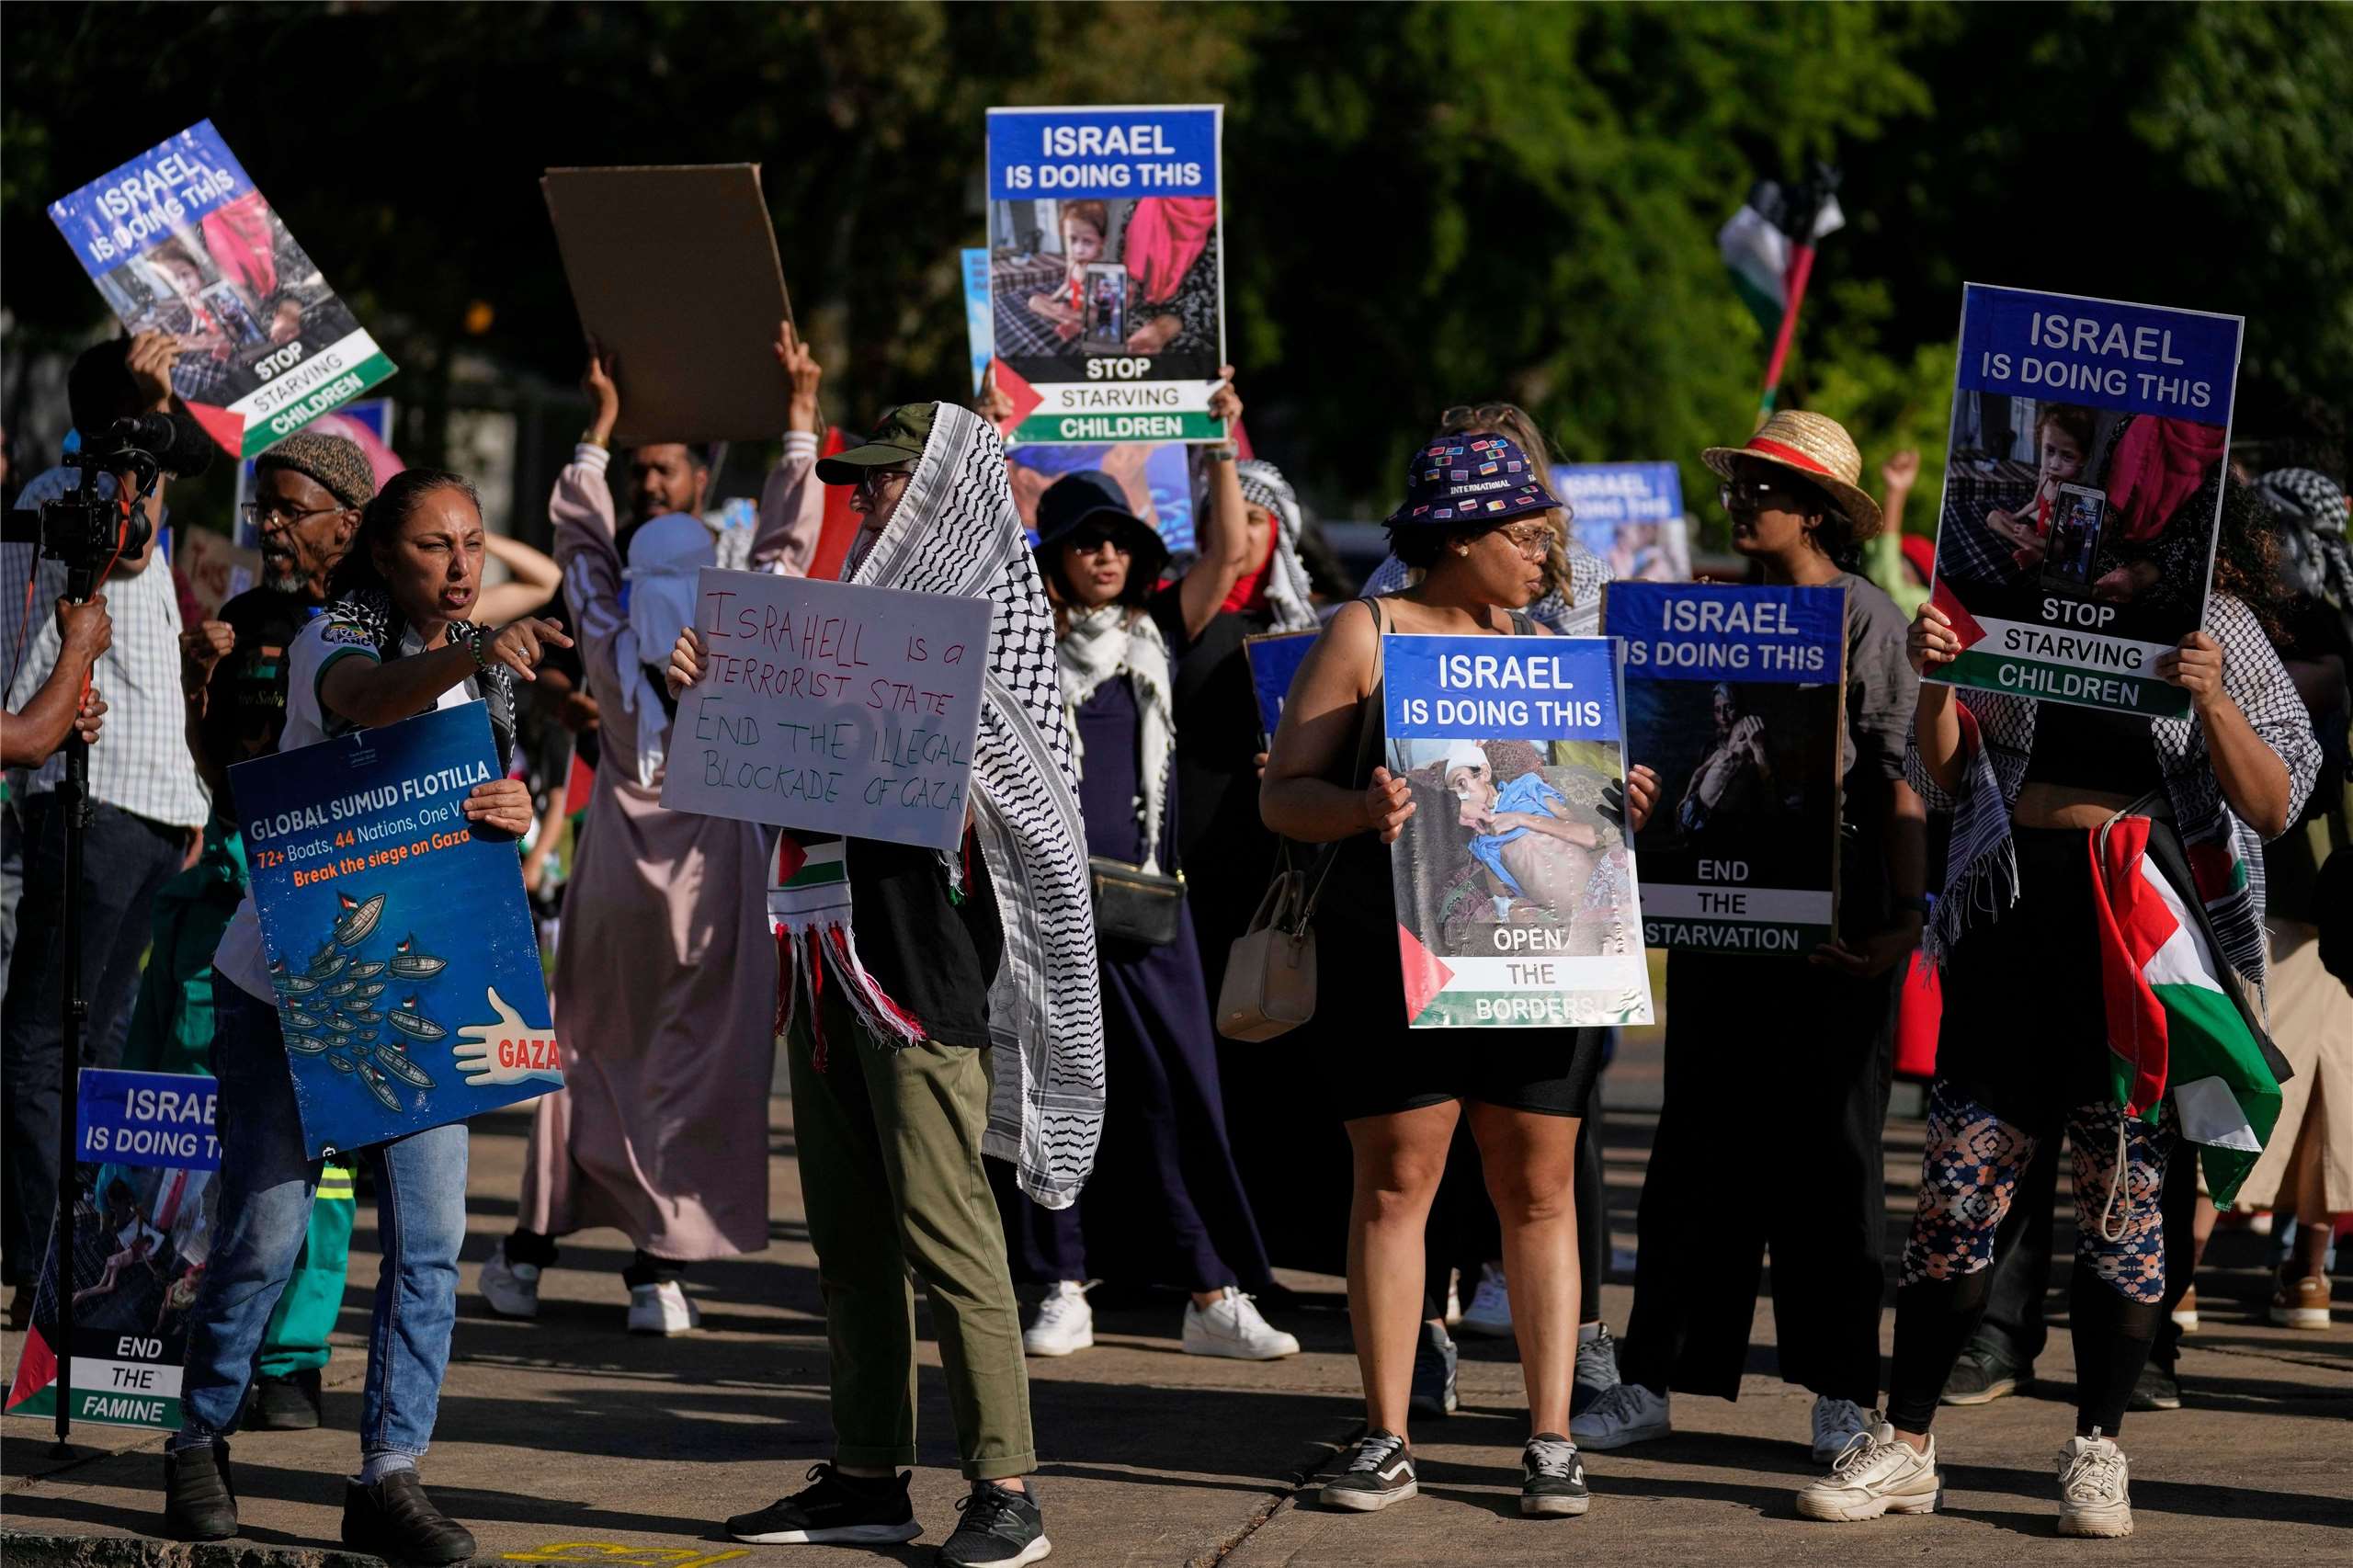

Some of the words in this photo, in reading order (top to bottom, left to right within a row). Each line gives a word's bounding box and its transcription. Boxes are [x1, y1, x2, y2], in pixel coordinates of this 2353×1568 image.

[1043, 125, 1176, 156] ISRAEL
[96, 153, 200, 221] ISRAEL
[1006, 165, 1033, 188] IS
[1039, 164, 1131, 187] DOING
[1136, 162, 1202, 187] THIS
[89, 236, 115, 263] IS
[113, 198, 185, 250] DOING
[181, 169, 234, 209] THIS
[2030, 312, 2184, 365] ISRAEL
[255, 341, 302, 381] STOP
[1086, 358, 1151, 379] STOP
[255, 354, 342, 412] STARVING
[1983, 351, 2011, 380] IS
[2021, 357, 2127, 396] DOING
[2137, 373, 2211, 407] THIS
[271, 372, 364, 435] CHILDREN
[1062, 388, 1179, 407] STARVING
[1060, 416, 1183, 438] CHILDREN
[1450, 479, 1511, 494] INTERNATIONAL
[1663, 599, 1799, 634] ISRAEL
[2041, 597, 2115, 628] STOP
[707, 591, 869, 667] ISRAHELL
[944, 644, 965, 665] a
[1656, 642, 1750, 668] DOING
[1757, 644, 1824, 670] THIS
[2004, 629, 2143, 669] STARVING
[710, 653, 852, 699] TERRORIST
[867, 679, 953, 715] STATE
[1439, 654, 1574, 689] ISRAEL
[1998, 663, 2140, 706] CHILDREN
[1404, 699, 1428, 724] IS
[1437, 699, 1529, 726] DOING
[1535, 700, 1602, 727] THIS
[696, 697, 760, 745] END
[778, 722, 853, 760] THE
[872, 728, 968, 768] ILLEGAL
[703, 749, 844, 802] BLOCKADE
[864, 777, 897, 805] OF
[901, 777, 962, 813] GAZA
[250, 804, 329, 841] GLOBAL
[330, 785, 399, 821] SUMUD
[401, 760, 491, 802] FLOTILLA
[256, 850, 285, 869] 72+
[287, 839, 334, 861] Boats,
[335, 829, 355, 848] 44
[357, 817, 417, 844] Nations,
[419, 807, 449, 825] One
[449, 800, 460, 817] V
[293, 862, 338, 887] Break
[339, 858, 366, 875] the
[368, 846, 407, 868] siege
[411, 839, 430, 856] on
[431, 829, 470, 849] Gaza
[1698, 859, 1748, 881] END
[1698, 892, 1746, 914] THE
[1494, 928, 1563, 950] OPEN
[1644, 923, 1799, 950] STARVATION
[1506, 963, 1556, 984] THE
[1476, 997, 1596, 1020] BORDERS
[498, 1039, 561, 1070] GAZA
[125, 1088, 218, 1125] ISRAE
[85, 1126, 109, 1151] IS
[115, 1129, 198, 1157] DOING
[117, 1335, 163, 1358] END
[112, 1368, 154, 1389] THE
[83, 1396, 165, 1422] FAMINE
